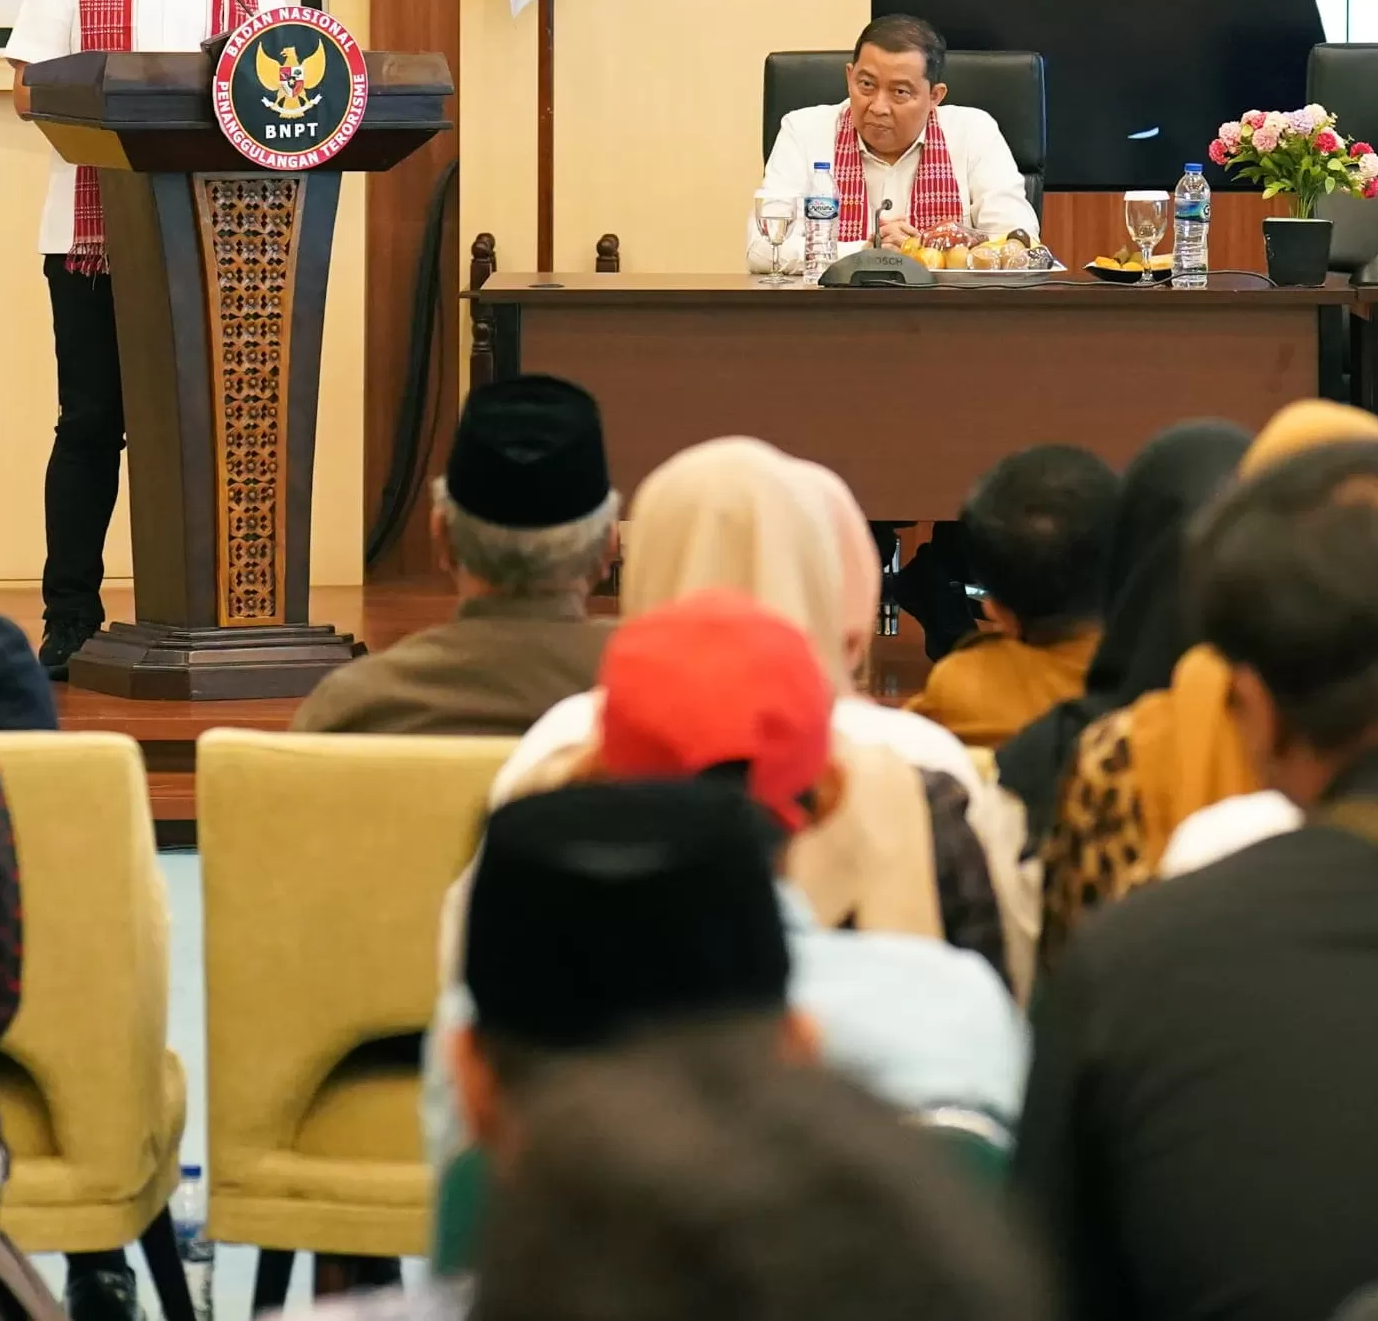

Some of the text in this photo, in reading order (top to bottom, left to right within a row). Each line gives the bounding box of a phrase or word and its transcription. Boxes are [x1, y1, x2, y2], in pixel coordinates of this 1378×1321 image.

[226, 8, 355, 58] BADAN NASIONAL
[217, 73, 365, 168] PENANGGULANGAN TERORISME
[265, 123, 319, 139] BNPT
